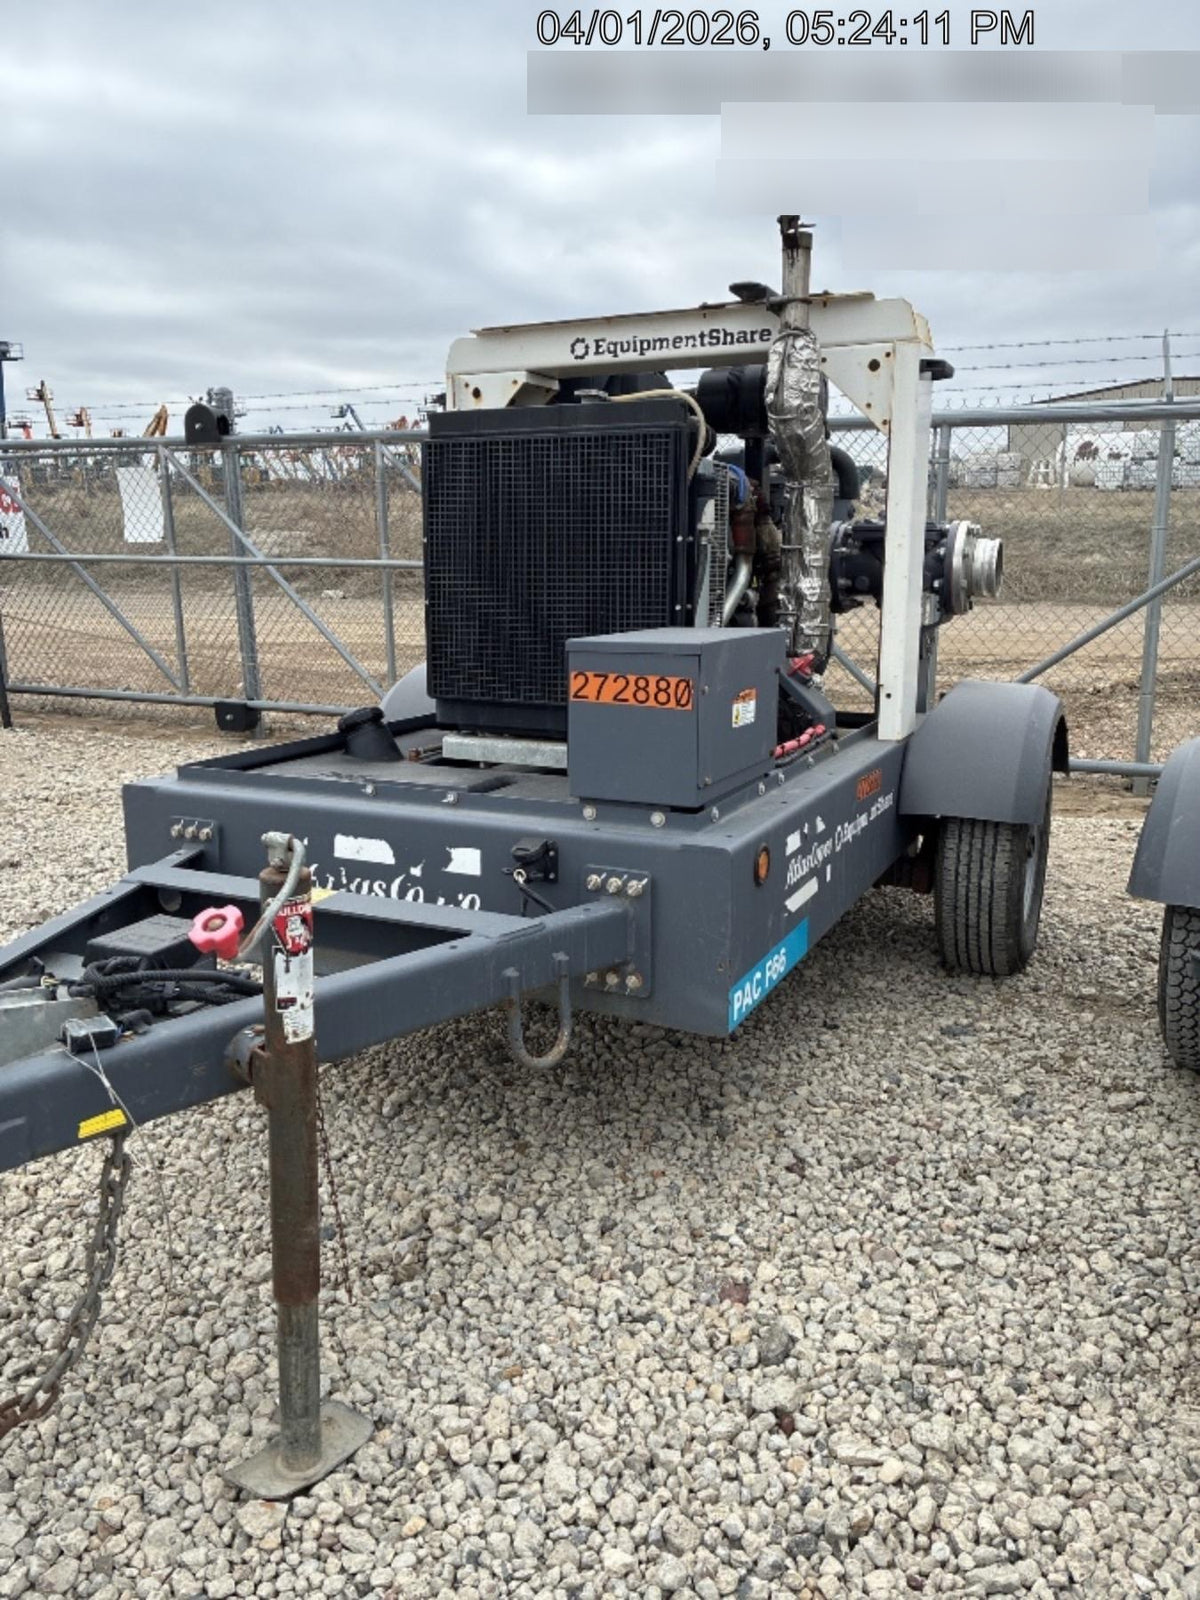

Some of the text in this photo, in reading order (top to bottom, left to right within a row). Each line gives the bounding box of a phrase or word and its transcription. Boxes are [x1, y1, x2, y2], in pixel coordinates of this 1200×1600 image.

[593, 327, 772, 359] EquipmentShare
[572, 672, 691, 708] 272880
[733, 971, 762, 1021] PAC
